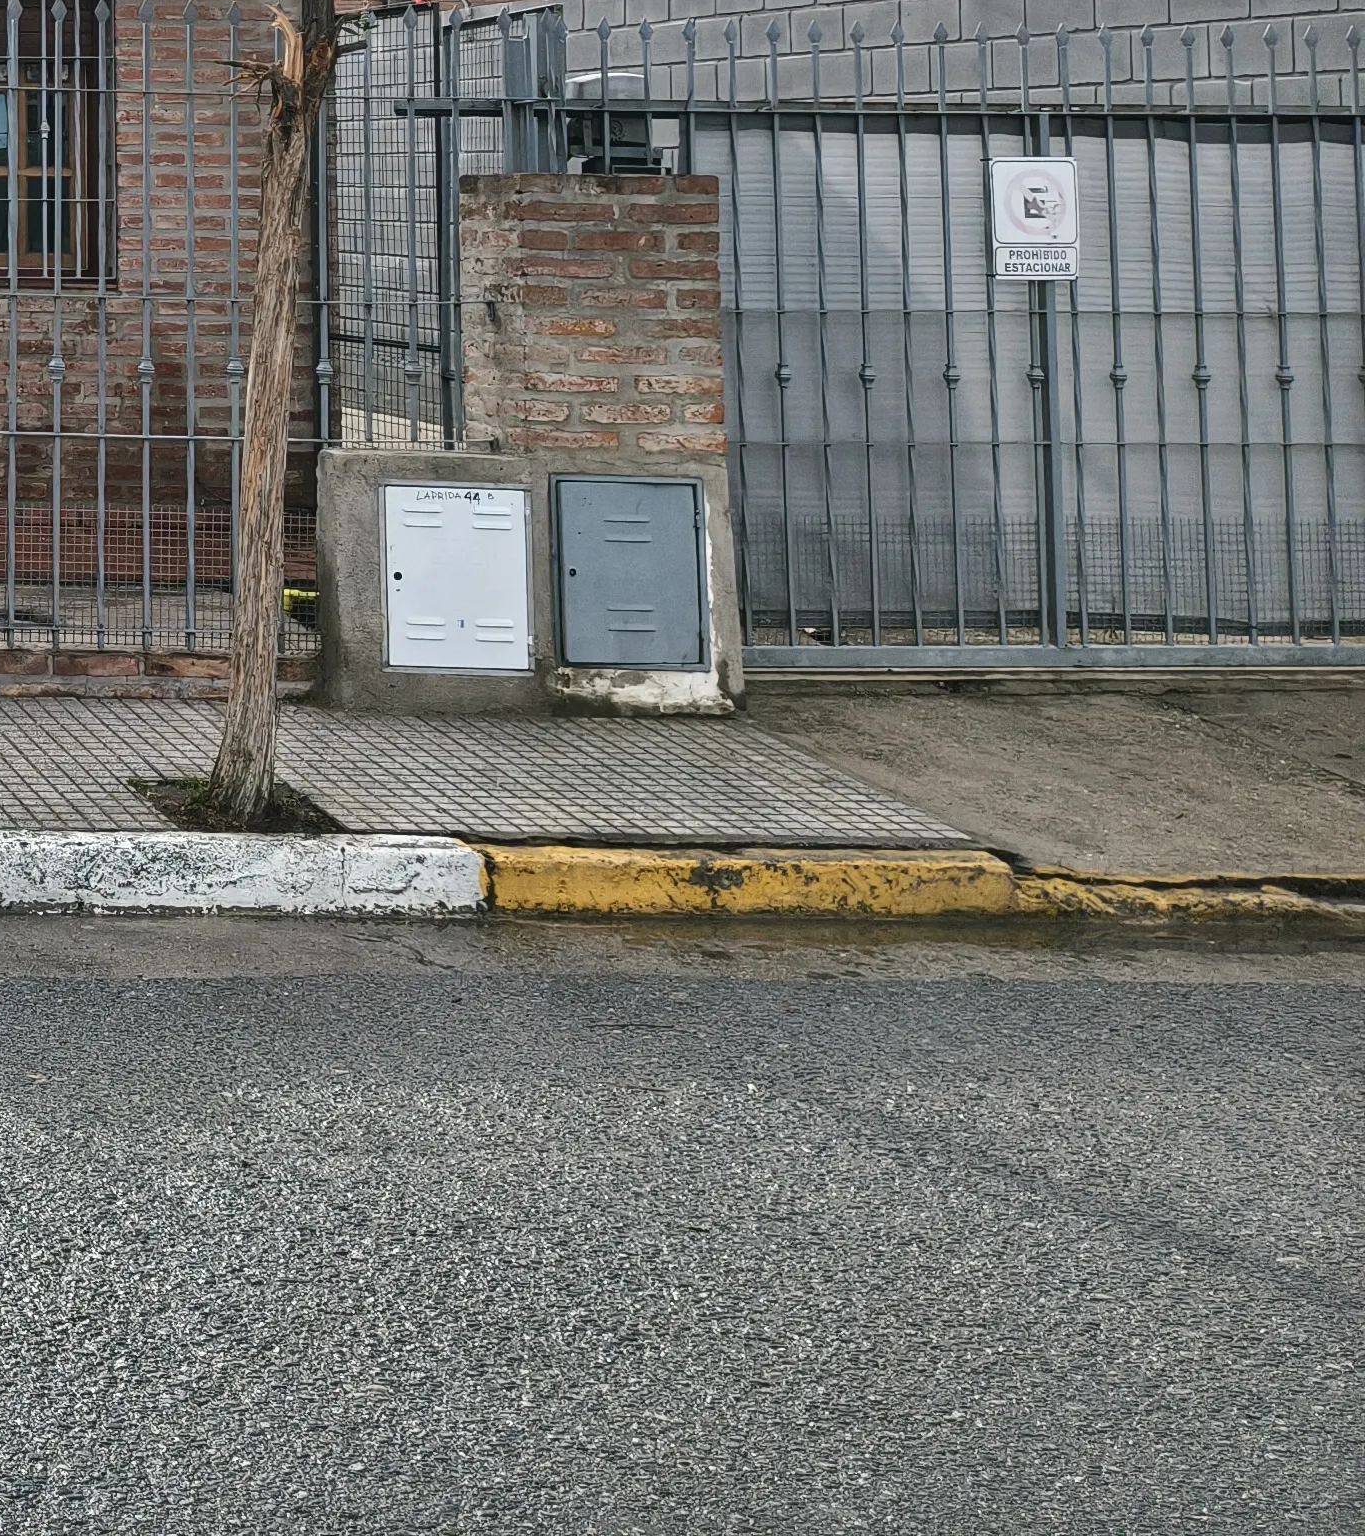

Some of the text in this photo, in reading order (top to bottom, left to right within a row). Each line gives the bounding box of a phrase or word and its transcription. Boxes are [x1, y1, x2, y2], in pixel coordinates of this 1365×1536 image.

[1009, 250, 1067, 260] PROHIBIDO
[1004, 263, 1071, 273] ESTACIONAR
[416, 491, 461, 500] LAPRIDA
